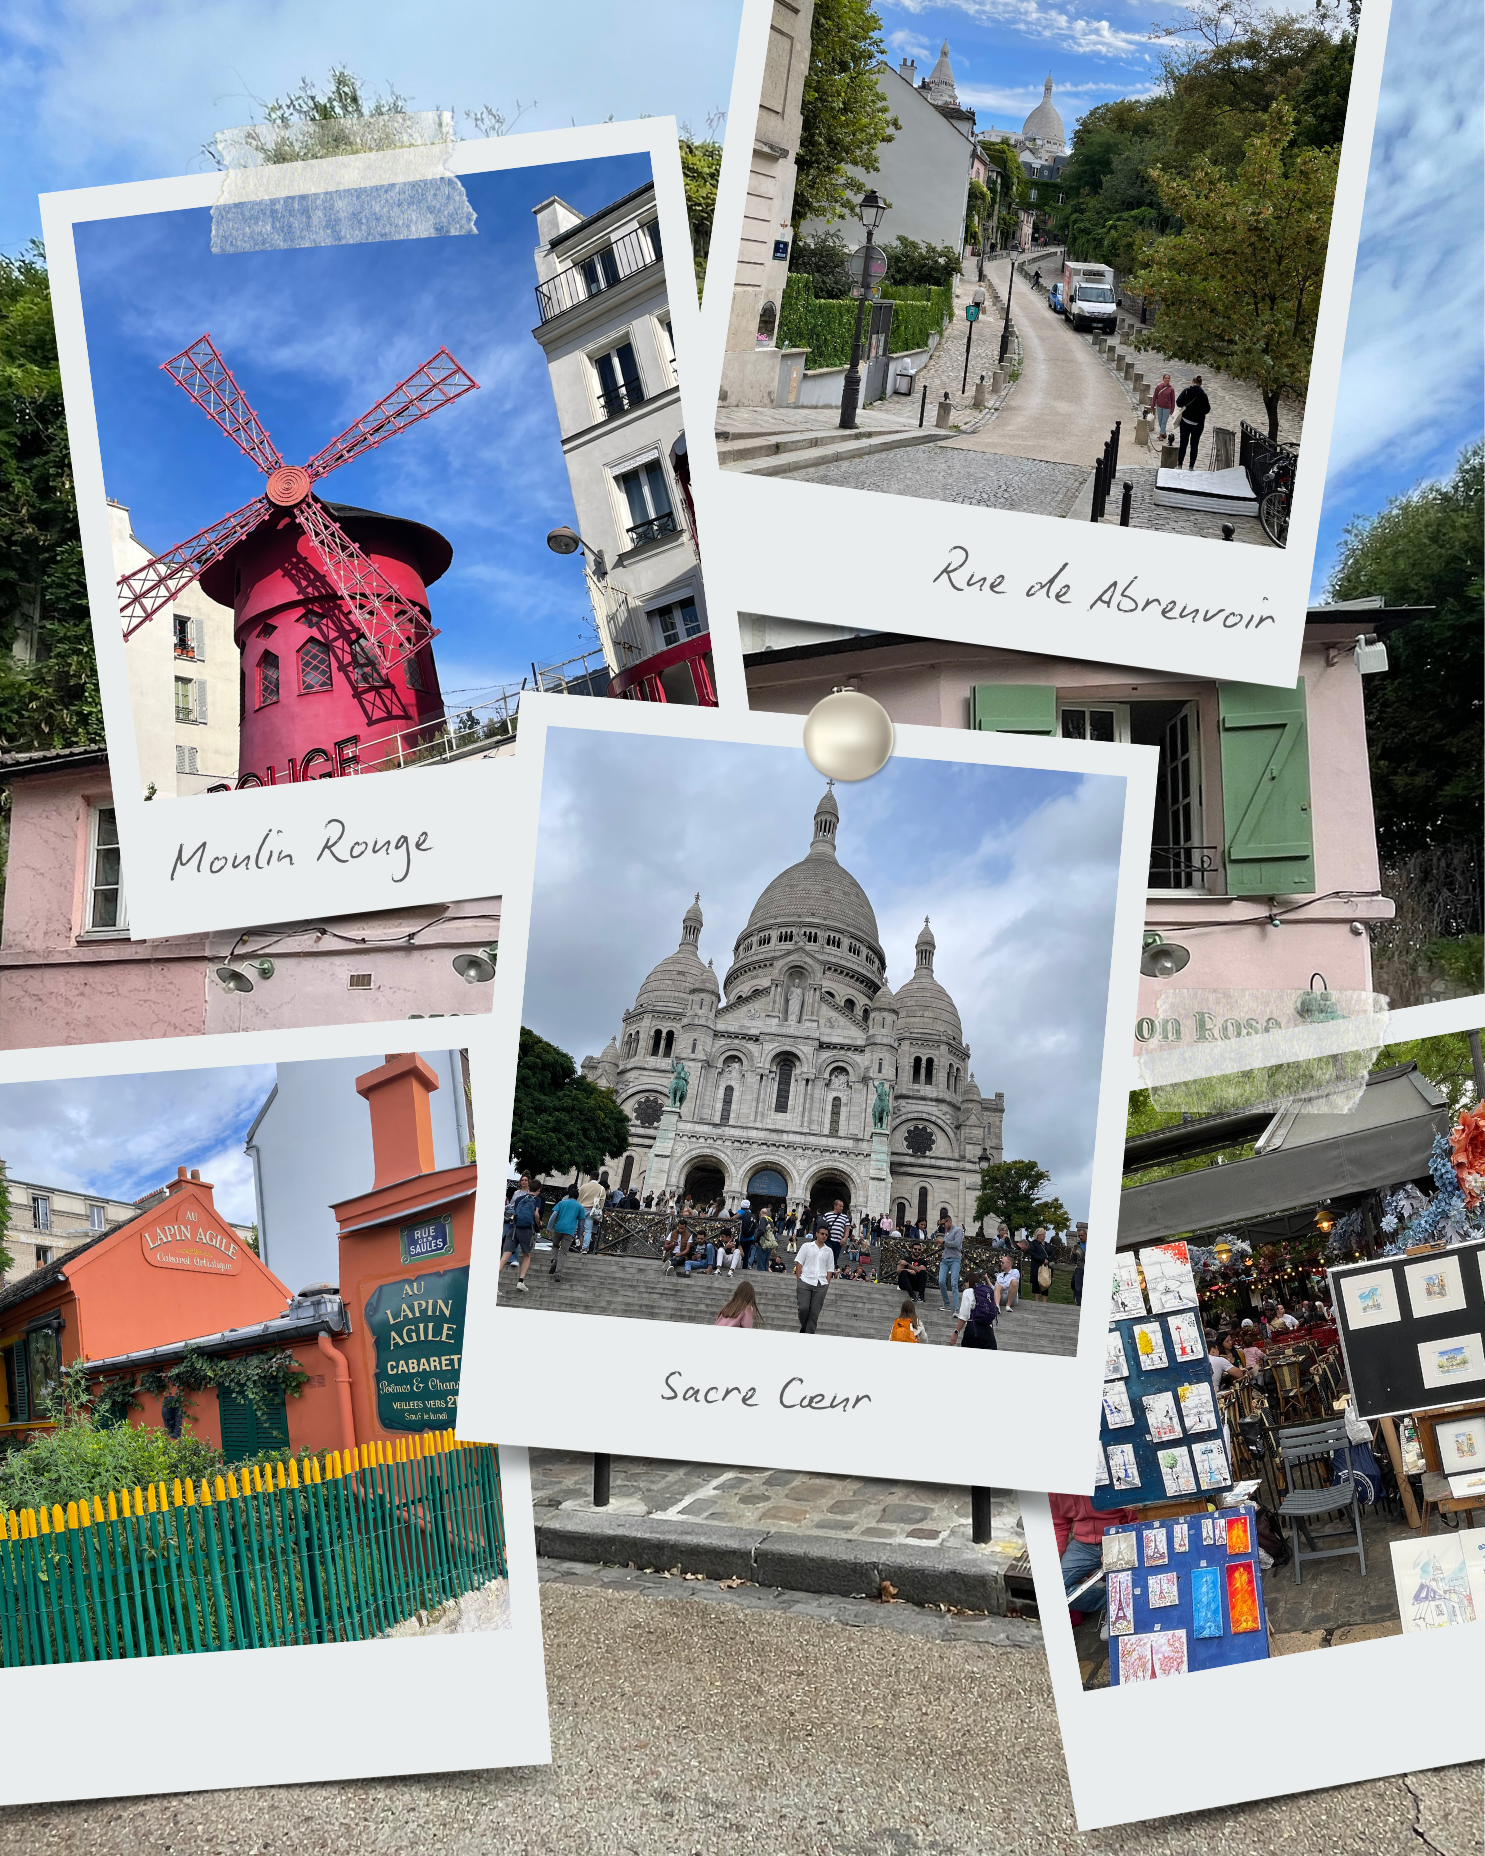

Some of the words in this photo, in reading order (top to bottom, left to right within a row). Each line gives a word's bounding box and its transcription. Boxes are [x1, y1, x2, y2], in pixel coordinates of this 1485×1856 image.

[1193, 1011, 1282, 1042] Rose
[185, 1210, 198, 1222] AU
[414, 1226, 436, 1239] RUE
[418, 1236, 433, 1244] DES
[143, 1225, 191, 1250] LAPIN
[195, 1227, 238, 1260] AGILE
[410, 1239, 443, 1254] SAULES
[156, 1252, 191, 1266] Cabaret
[401, 1281, 424, 1299] AU
[385, 1299, 453, 1325] LAPIN
[390, 1322, 457, 1350] AGILE
[387, 1354, 462, 1375] CABARET
[413, 1376, 425, 1393] &
[425, 1400, 446, 1408] VERS
[404, 1412, 422, 1420] Sauf
[423, 1412, 429, 1420] le
[429, 1411, 448, 1420] lundi
